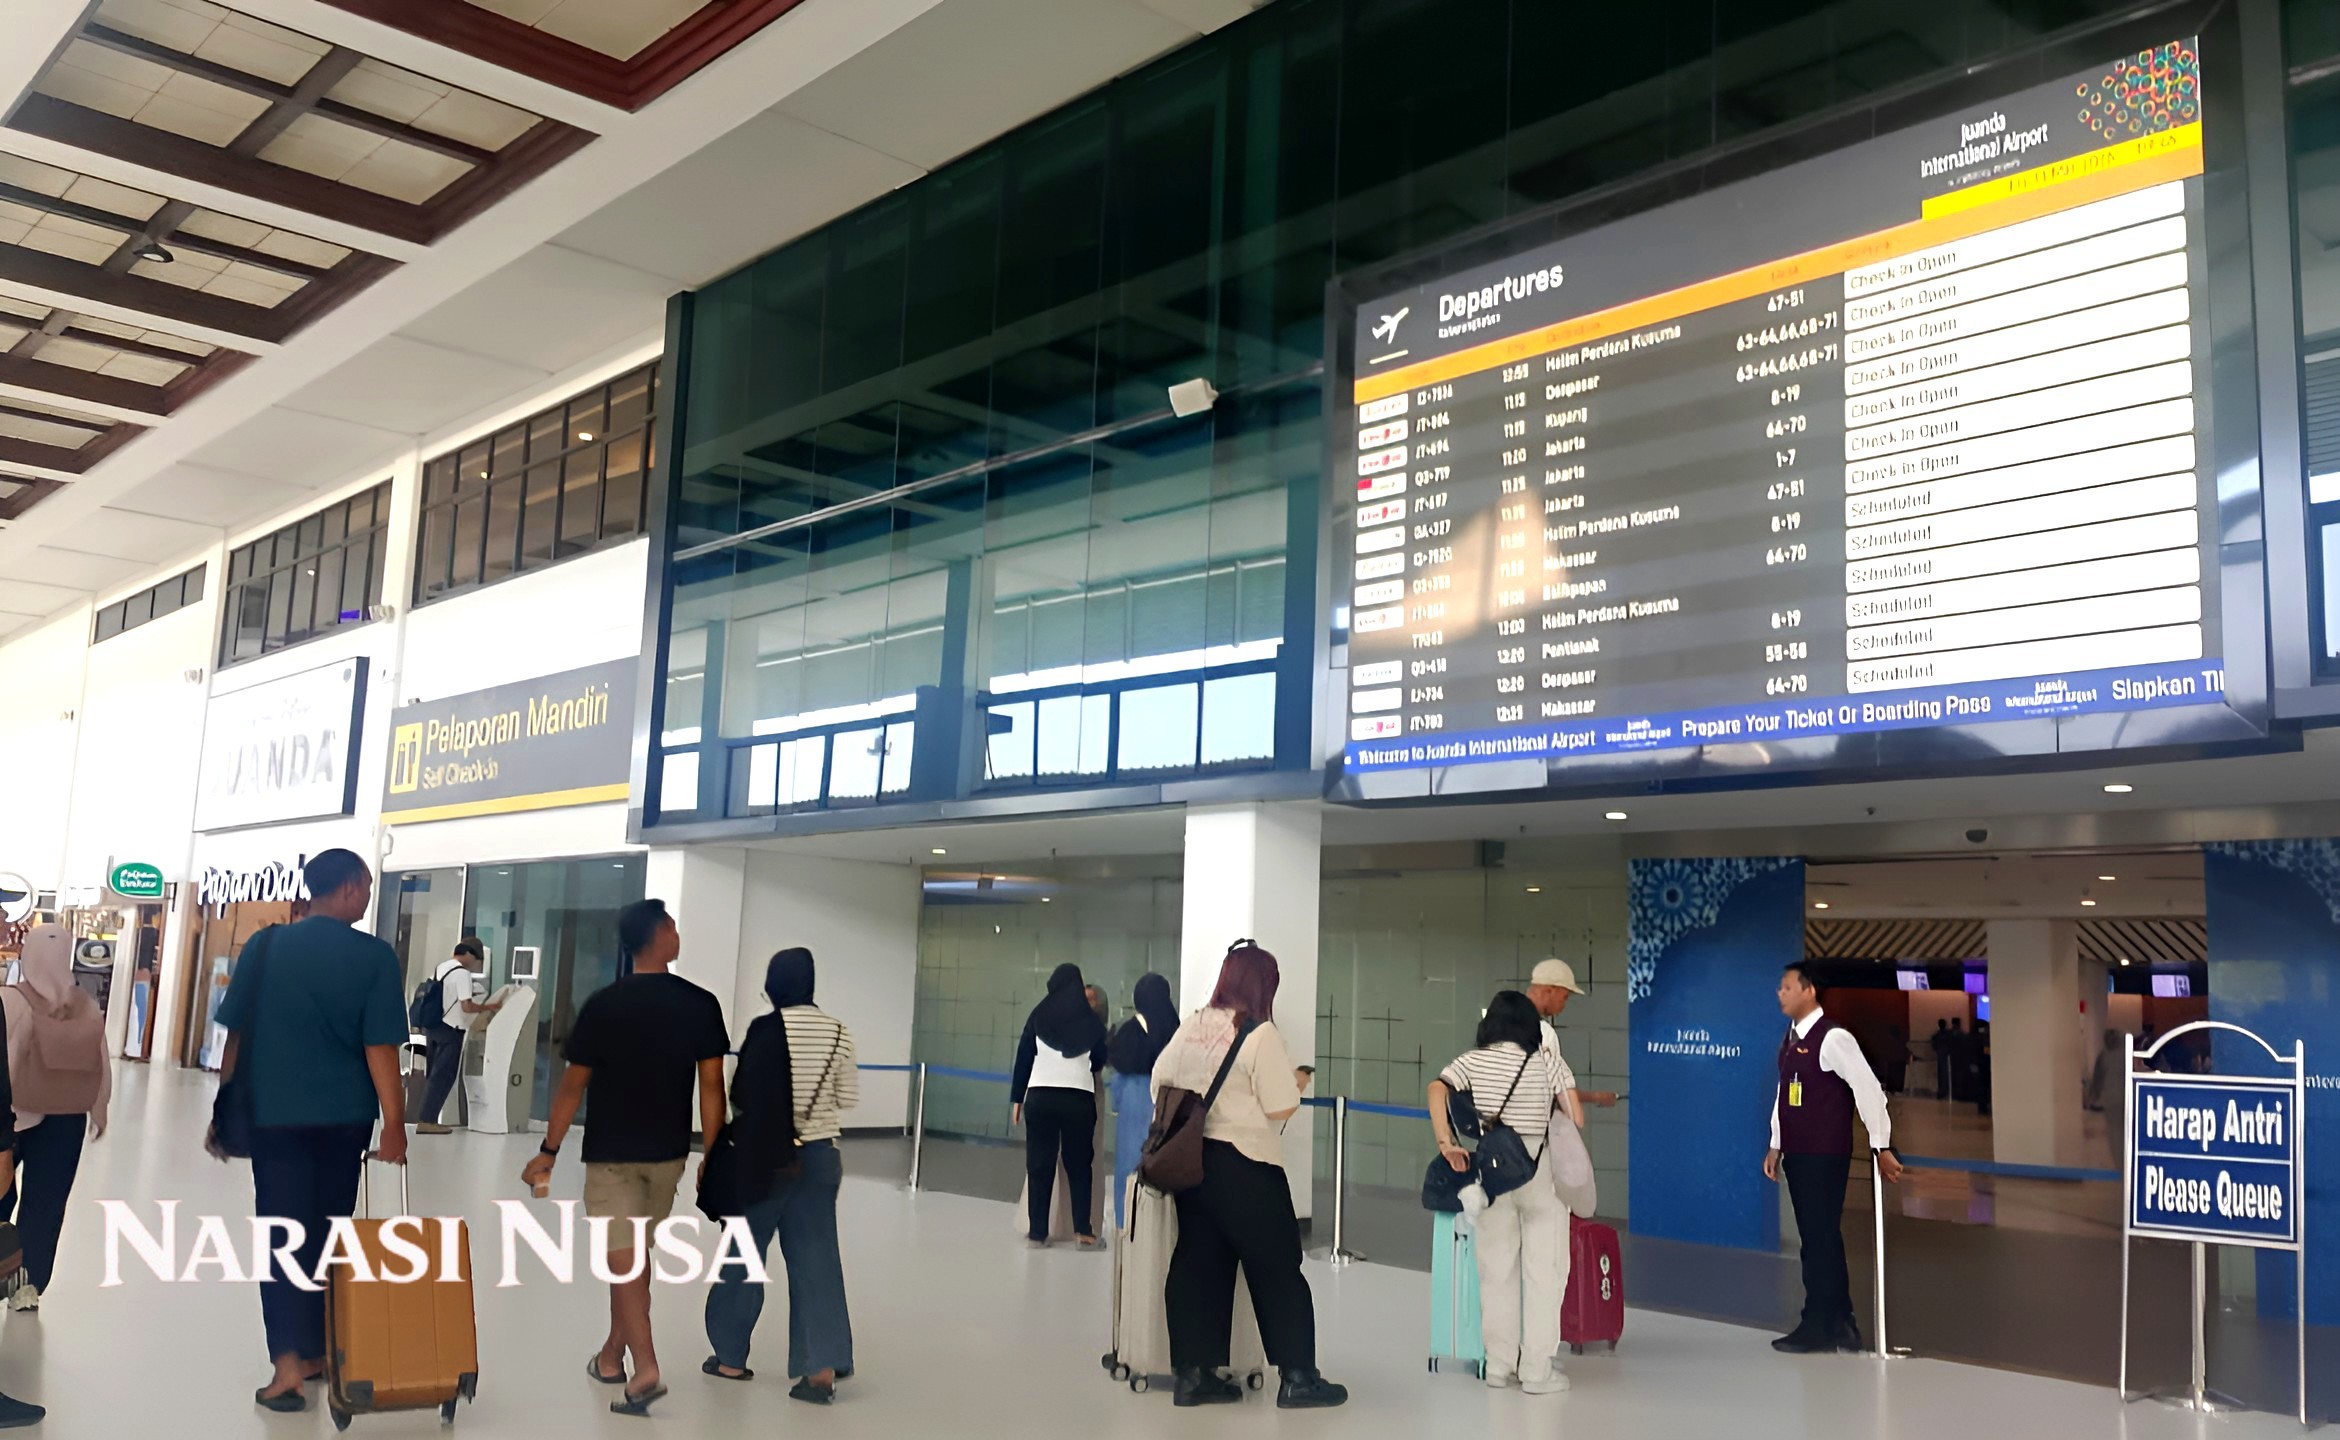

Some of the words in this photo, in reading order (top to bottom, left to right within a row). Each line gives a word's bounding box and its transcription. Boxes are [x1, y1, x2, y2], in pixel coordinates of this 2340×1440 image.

[1921, 138, 2000, 178] International
[2003, 123, 2048, 155] Airport
[1439, 265, 1563, 322] Departures
[426, 711, 520, 758] Pelaporan
[527, 682, 609, 737] Mandiri
[1412, 746, 1425, 761] to
[1469, 734, 1547, 757] International
[1551, 730, 1596, 752] Airport
[1682, 716, 1741, 738] Prepare
[1746, 713, 1781, 732] Your
[1785, 708, 1834, 730] Ticket
[1839, 705, 1857, 725] Or
[1862, 698, 1941, 724] Boarding
[1946, 695, 1991, 714] Pass
[2112, 675, 2195, 702] Siapkan
[2146, 1094, 2217, 1152] Harap
[2223, 1099, 2283, 1146] Antri
[2145, 1164, 2211, 1215] Please
[2216, 1169, 2283, 1221] Queue
